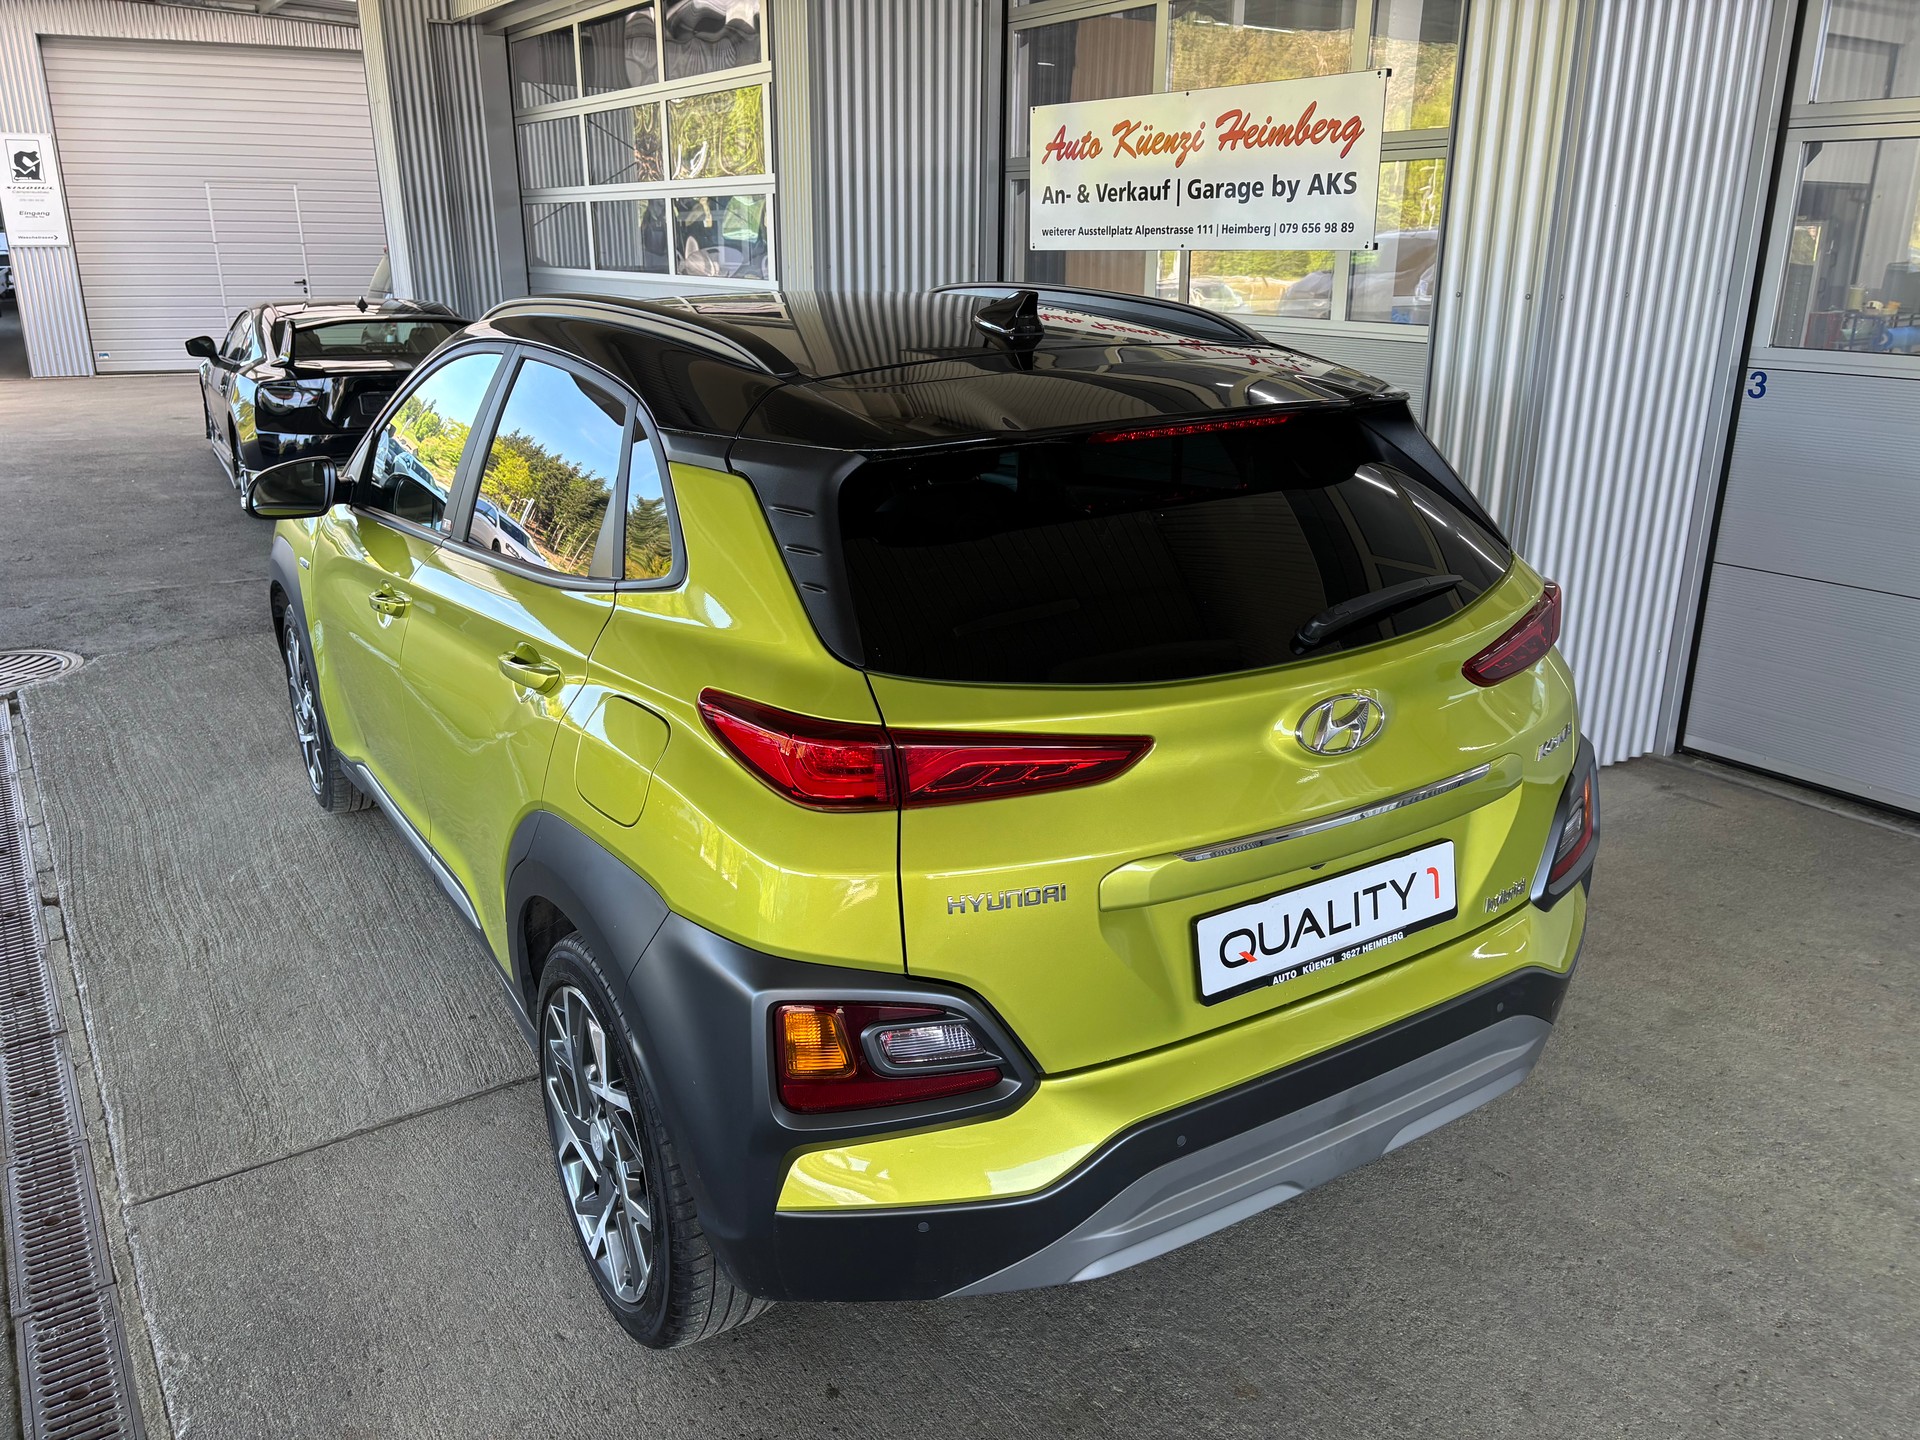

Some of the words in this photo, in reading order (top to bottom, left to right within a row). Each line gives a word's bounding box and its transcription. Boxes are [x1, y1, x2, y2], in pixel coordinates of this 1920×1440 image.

[1041, 124, 1103, 165] Auto
[1112, 119, 1206, 169] Küenzi
[1215, 100, 1365, 159] Heimberg
[1041, 185, 1072, 205] An-
[1077, 183, 1090, 204] &
[1095, 178, 1171, 203] Verkauf
[1187, 178, 1264, 204] Garage
[1271, 174, 1301, 203] by
[1307, 171, 1357, 196] AKS
[1041, 227, 1076, 236] weiterer
[1078, 225, 1133, 238] Ausstellplatz
[1135, 225, 1194, 237] Alpenstrasse
[1197, 224, 1213, 234] 111
[1221, 223, 1271, 237] Heimberg
[1279, 222, 1299, 234] 079
[1301, 222, 1321, 233] 656
[1324, 222, 1338, 233] 98
[1341, 222, 1355, 233] 89
[1747, 370, 1767, 399] 3
[947, 882, 1067, 915] HYUNDAI
[1272, 970, 1297, 986] AUTO
[1302, 956, 1335, 975] KÜENZI
[1340, 947, 1360, 961] 3627
[1362, 932, 1404, 953] HEIMBERG
